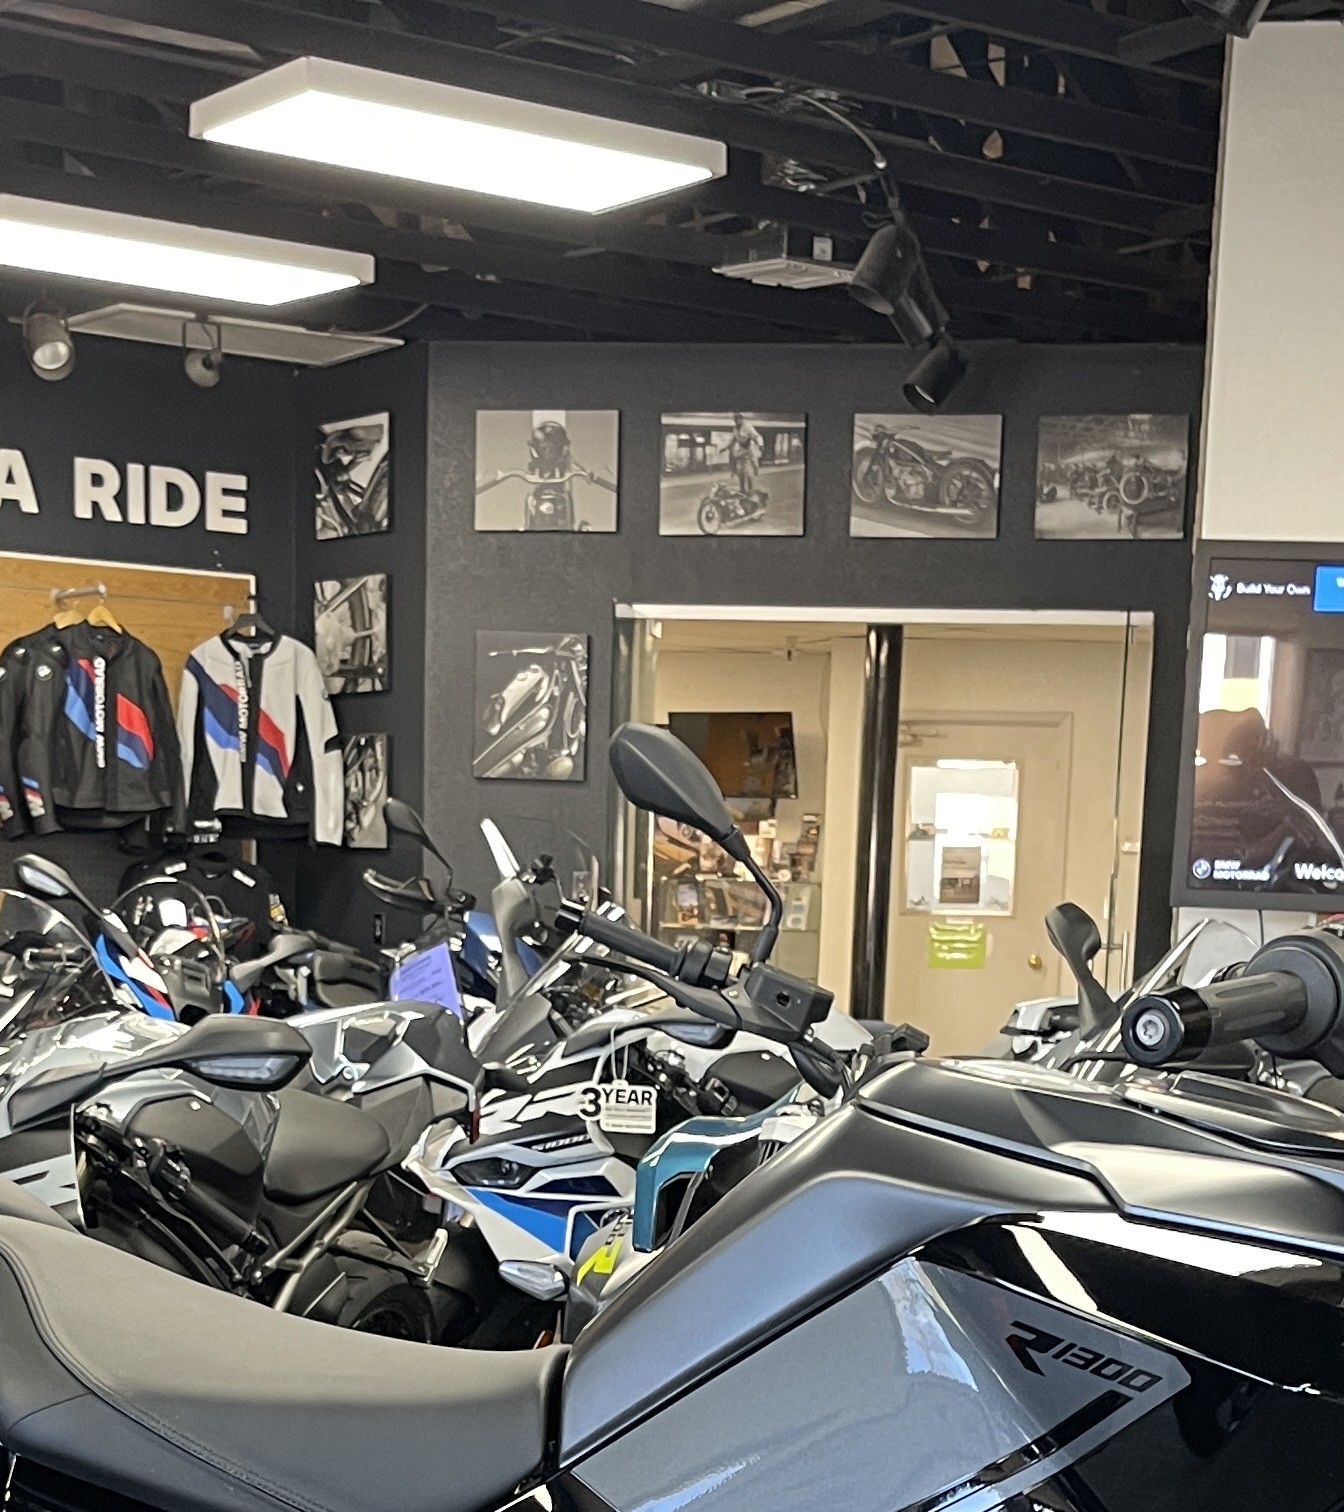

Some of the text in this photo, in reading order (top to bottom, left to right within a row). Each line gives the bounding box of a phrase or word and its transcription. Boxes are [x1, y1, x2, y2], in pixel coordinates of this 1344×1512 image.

[73, 456, 248, 534] RIDE
[579, 1087, 653, 1117] 3 YEAR
